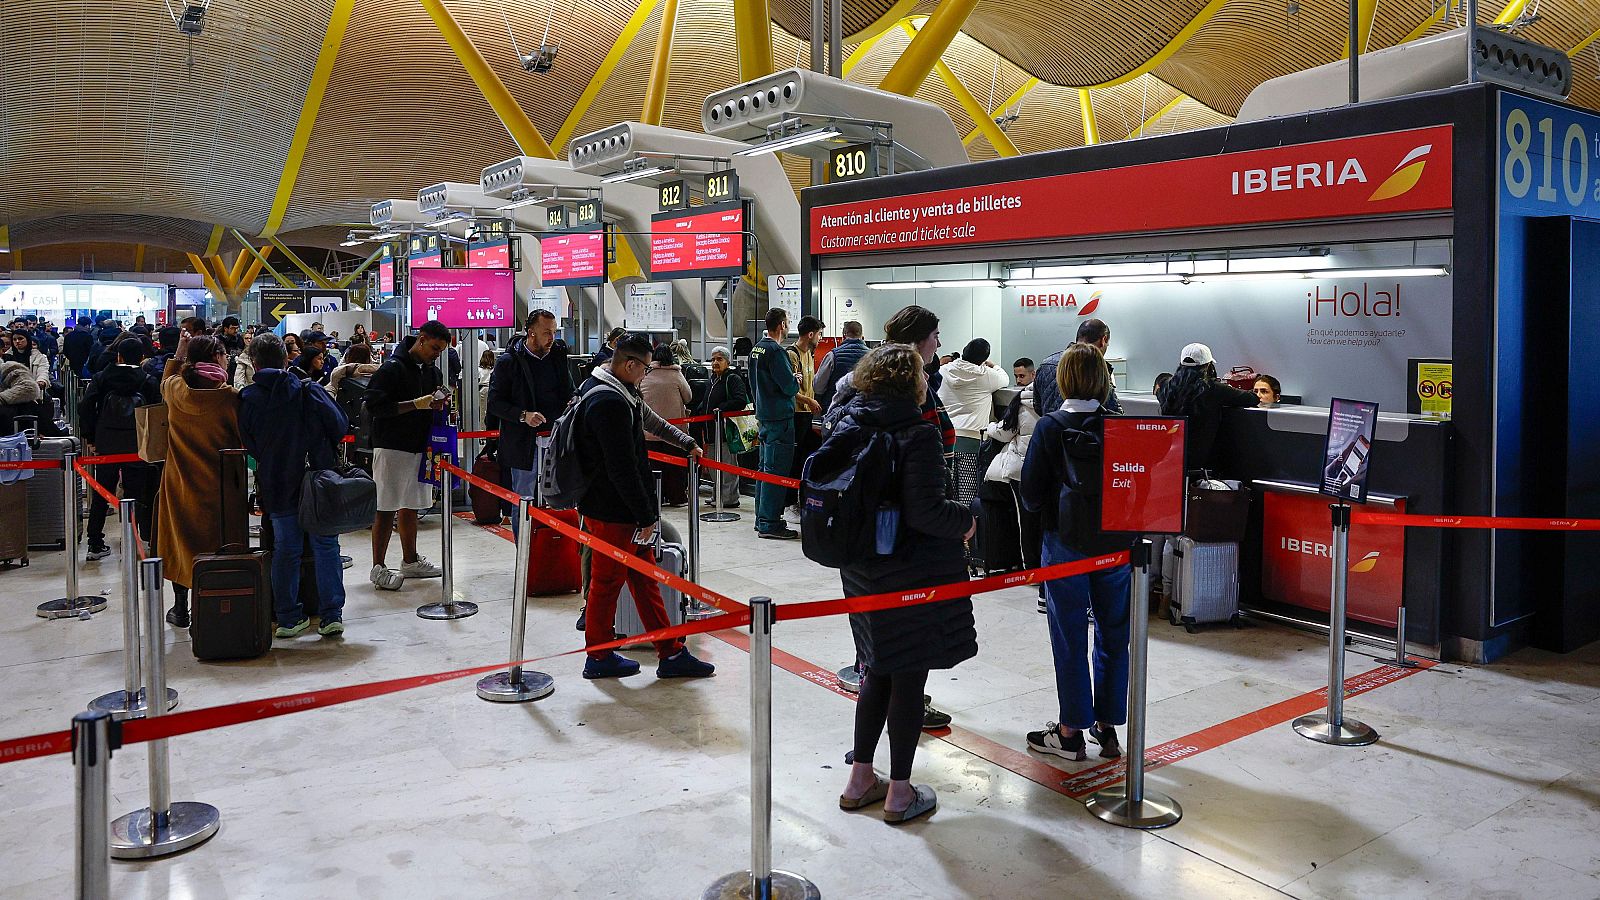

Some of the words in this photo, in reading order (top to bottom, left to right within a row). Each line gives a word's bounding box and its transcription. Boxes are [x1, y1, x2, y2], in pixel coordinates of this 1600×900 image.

[836, 150, 866, 177] 810
[1504, 108, 1588, 207] 810
[1232, 158, 1367, 195] IBERIA
[662, 186, 680, 206] 812
[708, 176, 729, 198] 811
[549, 210, 561, 226] 814
[580, 204, 594, 221] 813
[821, 212, 862, 228] Atención
[864, 211, 874, 224] al
[875, 206, 910, 222] cliente
[912, 208, 920, 222] y
[922, 203, 954, 217] venta
[956, 199, 971, 214] de
[973, 194, 1022, 212] billetes
[821, 235, 863, 249] Customer
[864, 231, 896, 244] service
[898, 226, 918, 242] and
[920, 224, 950, 240] ticket
[952, 222, 976, 238] sale
[32, 296, 58, 305] CASH
[1021, 294, 1077, 306] IBERIA
[1308, 282, 1400, 324] ¡Hola!
[1320, 328, 1334, 337] qué
[1334, 328, 1368, 337] podemos
[1370, 330, 1406, 338] ayudarte?
[1347, 338, 1363, 346] help
[1363, 339, 1380, 347] you?
[1112, 463, 1145, 472] Salida
[1112, 478, 1131, 488] Exit
[1281, 537, 1334, 558] IBERI
[902, 592, 926, 602] IBERIA
[1004, 575, 1026, 584] IBERIA
[1096, 557, 1115, 566] IBERIA
[1158, 746, 1198, 761] TURNO
